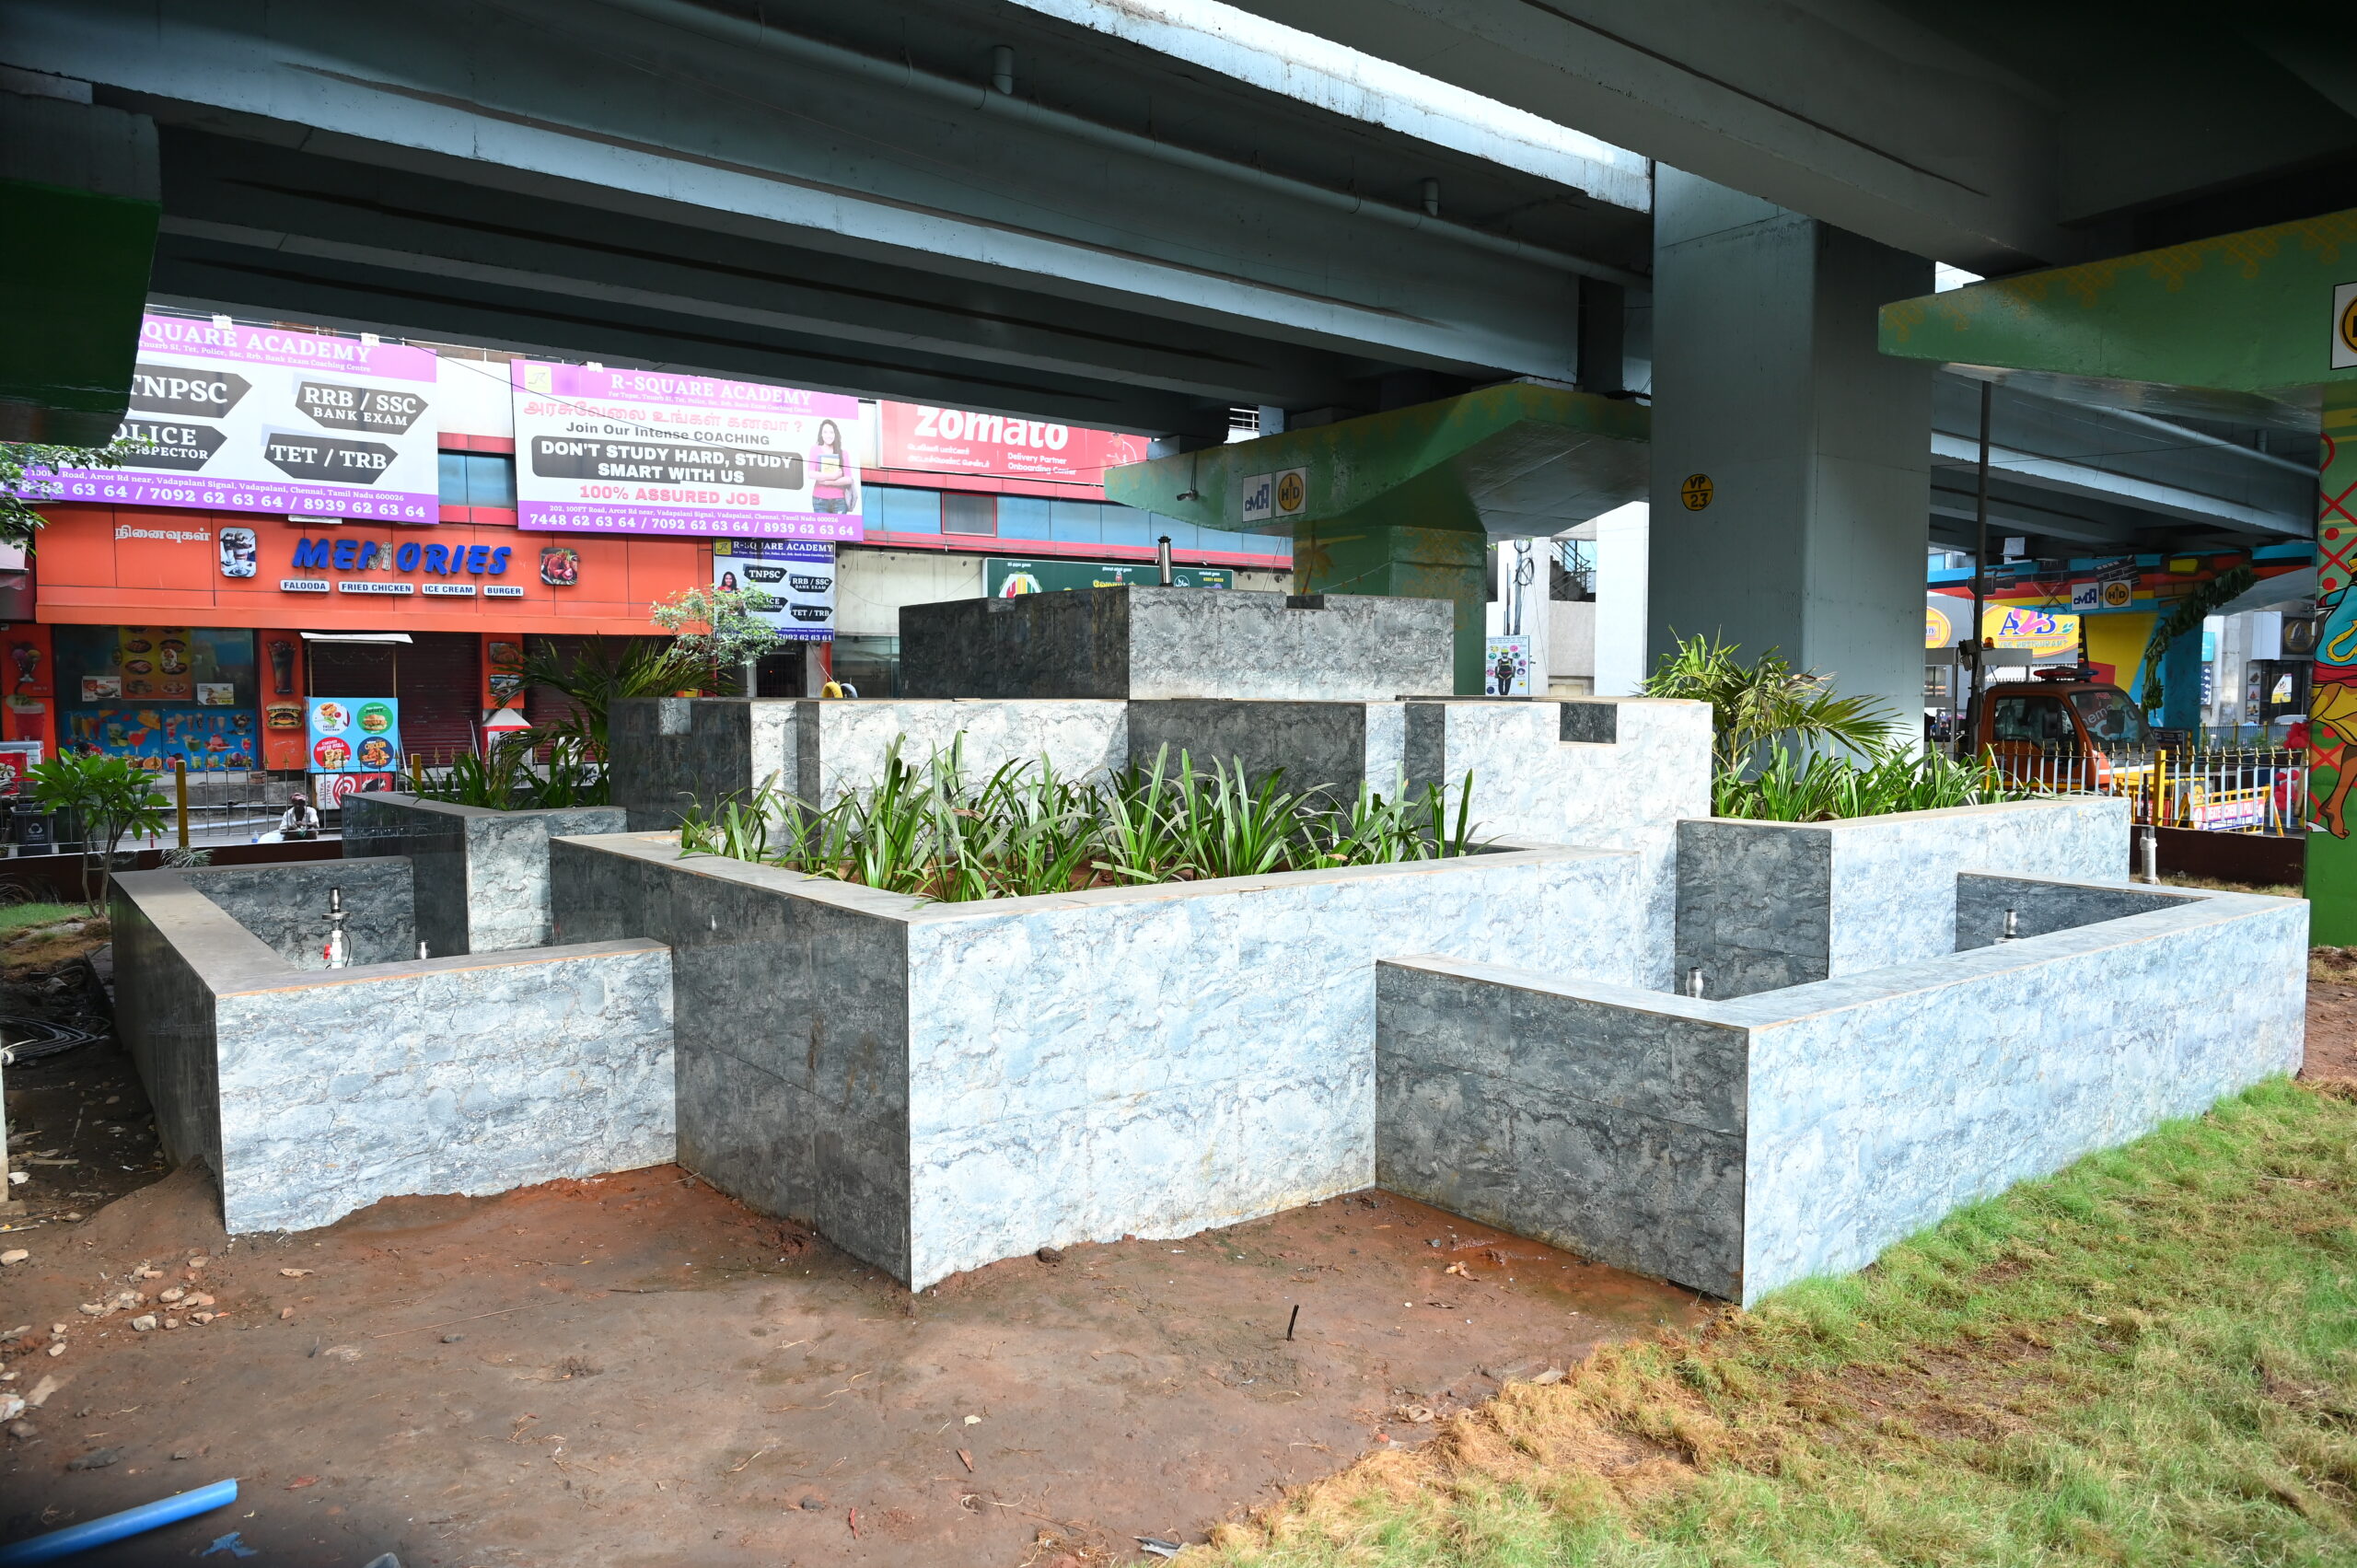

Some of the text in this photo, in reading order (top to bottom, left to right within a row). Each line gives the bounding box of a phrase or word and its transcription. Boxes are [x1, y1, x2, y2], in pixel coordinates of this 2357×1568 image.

[143, 321, 371, 363] QUARE ACADEMY
[265, 354, 285, 363] Bank
[287, 356, 309, 366] Exam
[310, 359, 344, 370] Coaching
[346, 362, 371, 372] Centre
[130, 374, 227, 404] TNPSC
[610, 374, 812, 406] R-SQUARE ACADEMY
[304, 387, 417, 413] RRB / SSC
[313, 406, 408, 426] BANK EXAM
[653, 409, 721, 427] உங்கள்
[727, 414, 789, 432] கனவா
[795, 421, 803, 433] ?
[111, 423, 197, 447] OLICE
[565, 422, 770, 446] Join Our Intense COACHING
[914, 405, 1069, 450] zomato
[270, 445, 387, 470] TET / TRB
[540, 440, 794, 469] DON'T STUDY HARD, STUDY
[1007, 452, 1067, 465] Delivery Partner
[598, 462, 745, 483] SMART WITH US
[1008, 462, 1051, 475] Onboarding
[62, 470, 87, 480] Road,
[90, 472, 114, 482] Arcot
[117, 474, 129, 482] Rd
[132, 476, 154, 484] near,
[157, 477, 205, 487] Vadapalani
[207, 481, 238, 491] Signal,
[239, 483, 288, 494] Vadapalani,
[290, 486, 325, 496] Chennai,
[328, 489, 351, 497] Tamil
[376, 494, 404, 502] 600026
[579, 484, 761, 505] 100% ASSURED JOB
[73, 483, 96, 496] 63
[104, 484, 128, 498] 64
[135, 485, 143, 500] /
[150, 487, 196, 503] 7092
[203, 492, 225, 504] 62
[233, 494, 254, 505] 63
[261, 495, 284, 507] 64
[290, 496, 297, 509] /
[304, 498, 346, 512] 8939
[353, 502, 373, 514] 62
[379, 504, 399, 516] 63
[405, 505, 425, 517] 64
[1690, 493, 1708, 507] 27
[529, 513, 853, 536] 7448 62 63 64 / 7092 62 63 64 / 8939 62 63 64
[657, 510, 693, 518] Vadapalani
[717, 512, 753, 521] Vadapalani,
[115, 524, 211, 543] நினைவுகள்
[292, 538, 512, 575] MEMORIES
[785, 543, 833, 552] ACADEMY
[749, 570, 781, 578] TNPSC
[284, 581, 326, 590] FALOODA
[342, 583, 412, 592] FRIED CHICKEN
[442, 586, 473, 594] CREAM
[487, 587, 521, 595] BURGER
[1998, 608, 2058, 635] A2B
[365, 741, 386, 749] CHICKEN
